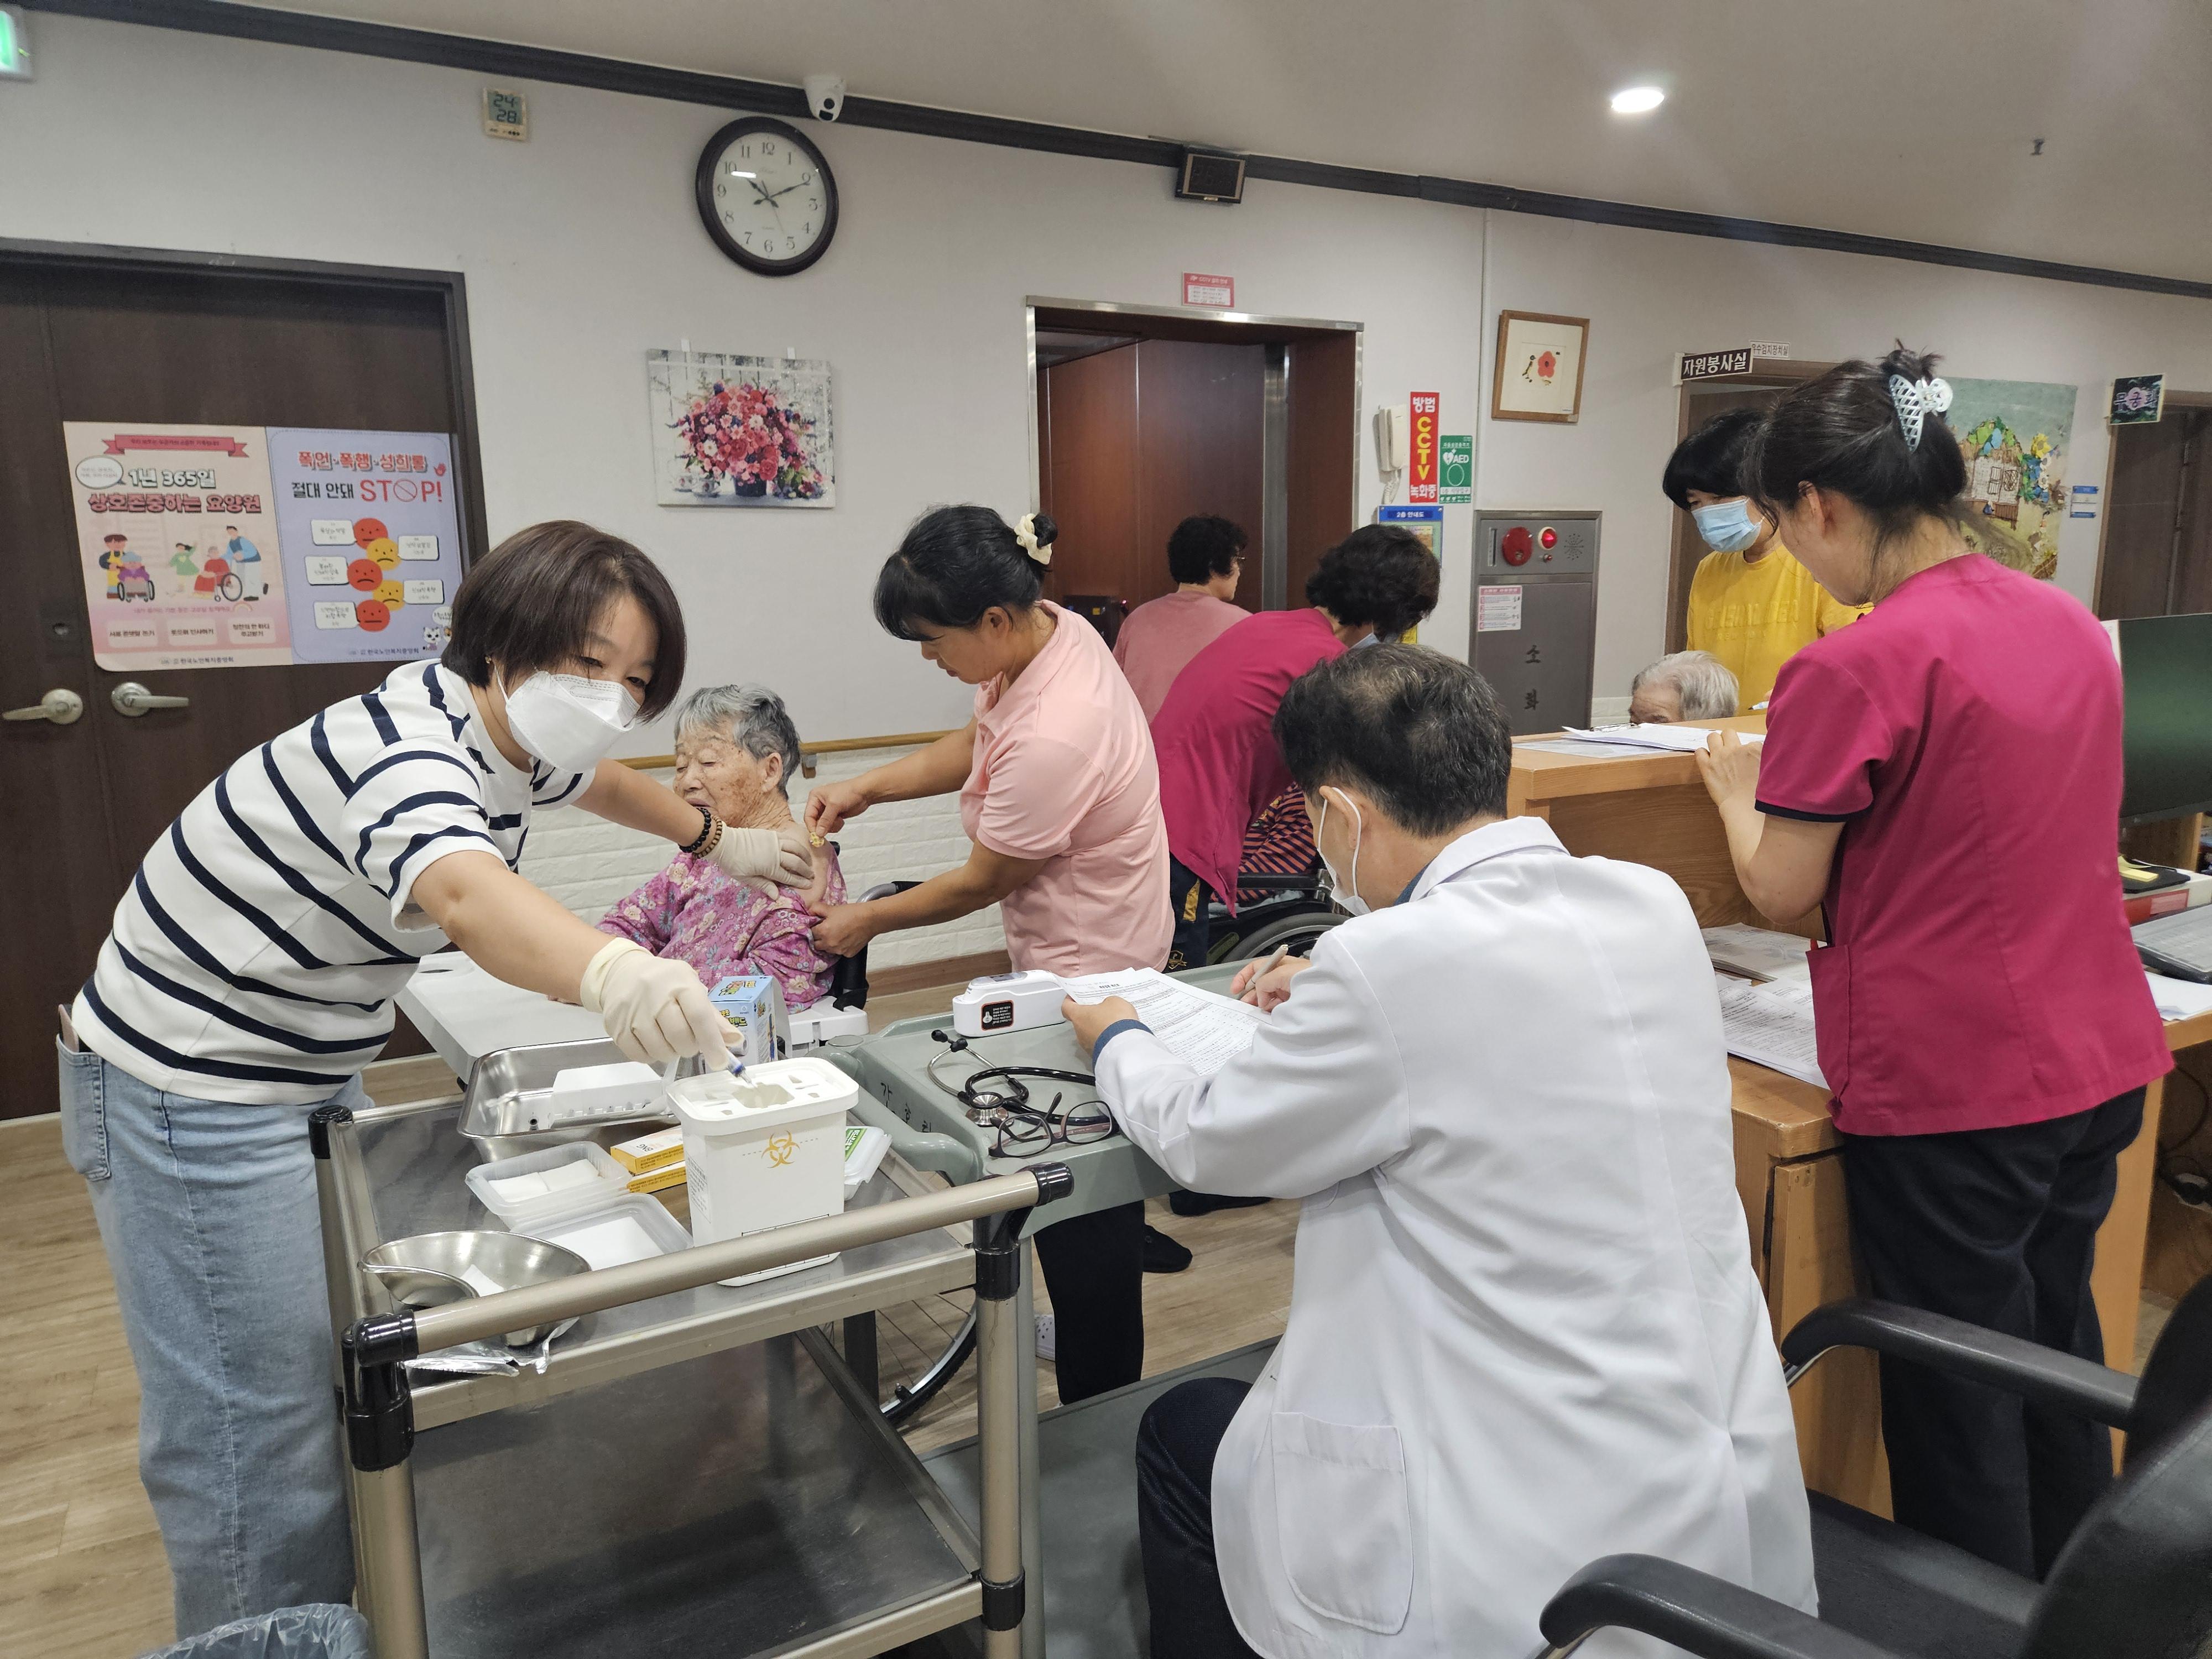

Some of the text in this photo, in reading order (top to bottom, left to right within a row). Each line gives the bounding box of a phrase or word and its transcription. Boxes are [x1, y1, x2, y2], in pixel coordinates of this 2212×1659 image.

[494, 94, 514, 108] 24
[497, 108, 517, 123] 28
[741, 145, 750, 158] 11
[762, 142, 775, 155] 12
[787, 152, 792, 165] 1
[717, 184, 727, 197] 9
[808, 198, 818, 211] 3
[724, 210, 734, 223] 8
[802, 222, 810, 234] 4
[744, 231, 752, 244] 7
[786, 236, 795, 249] 5
[764, 239, 773, 253] 6
[1683, 352, 1747, 376] 자원봉사실
[2114, 388, 2158, 411] 무궁화
[1411, 397, 1437, 498] 방범 CCTV 녹화중
[1453, 455, 1469, 463] AED
[128, 468, 158, 488] 1년
[162, 469, 216, 489] 365일
[291, 482, 321, 498] 절대
[326, 482, 354, 498] 안돼
[87, 493, 262, 514] 상호존중하는 요양원
